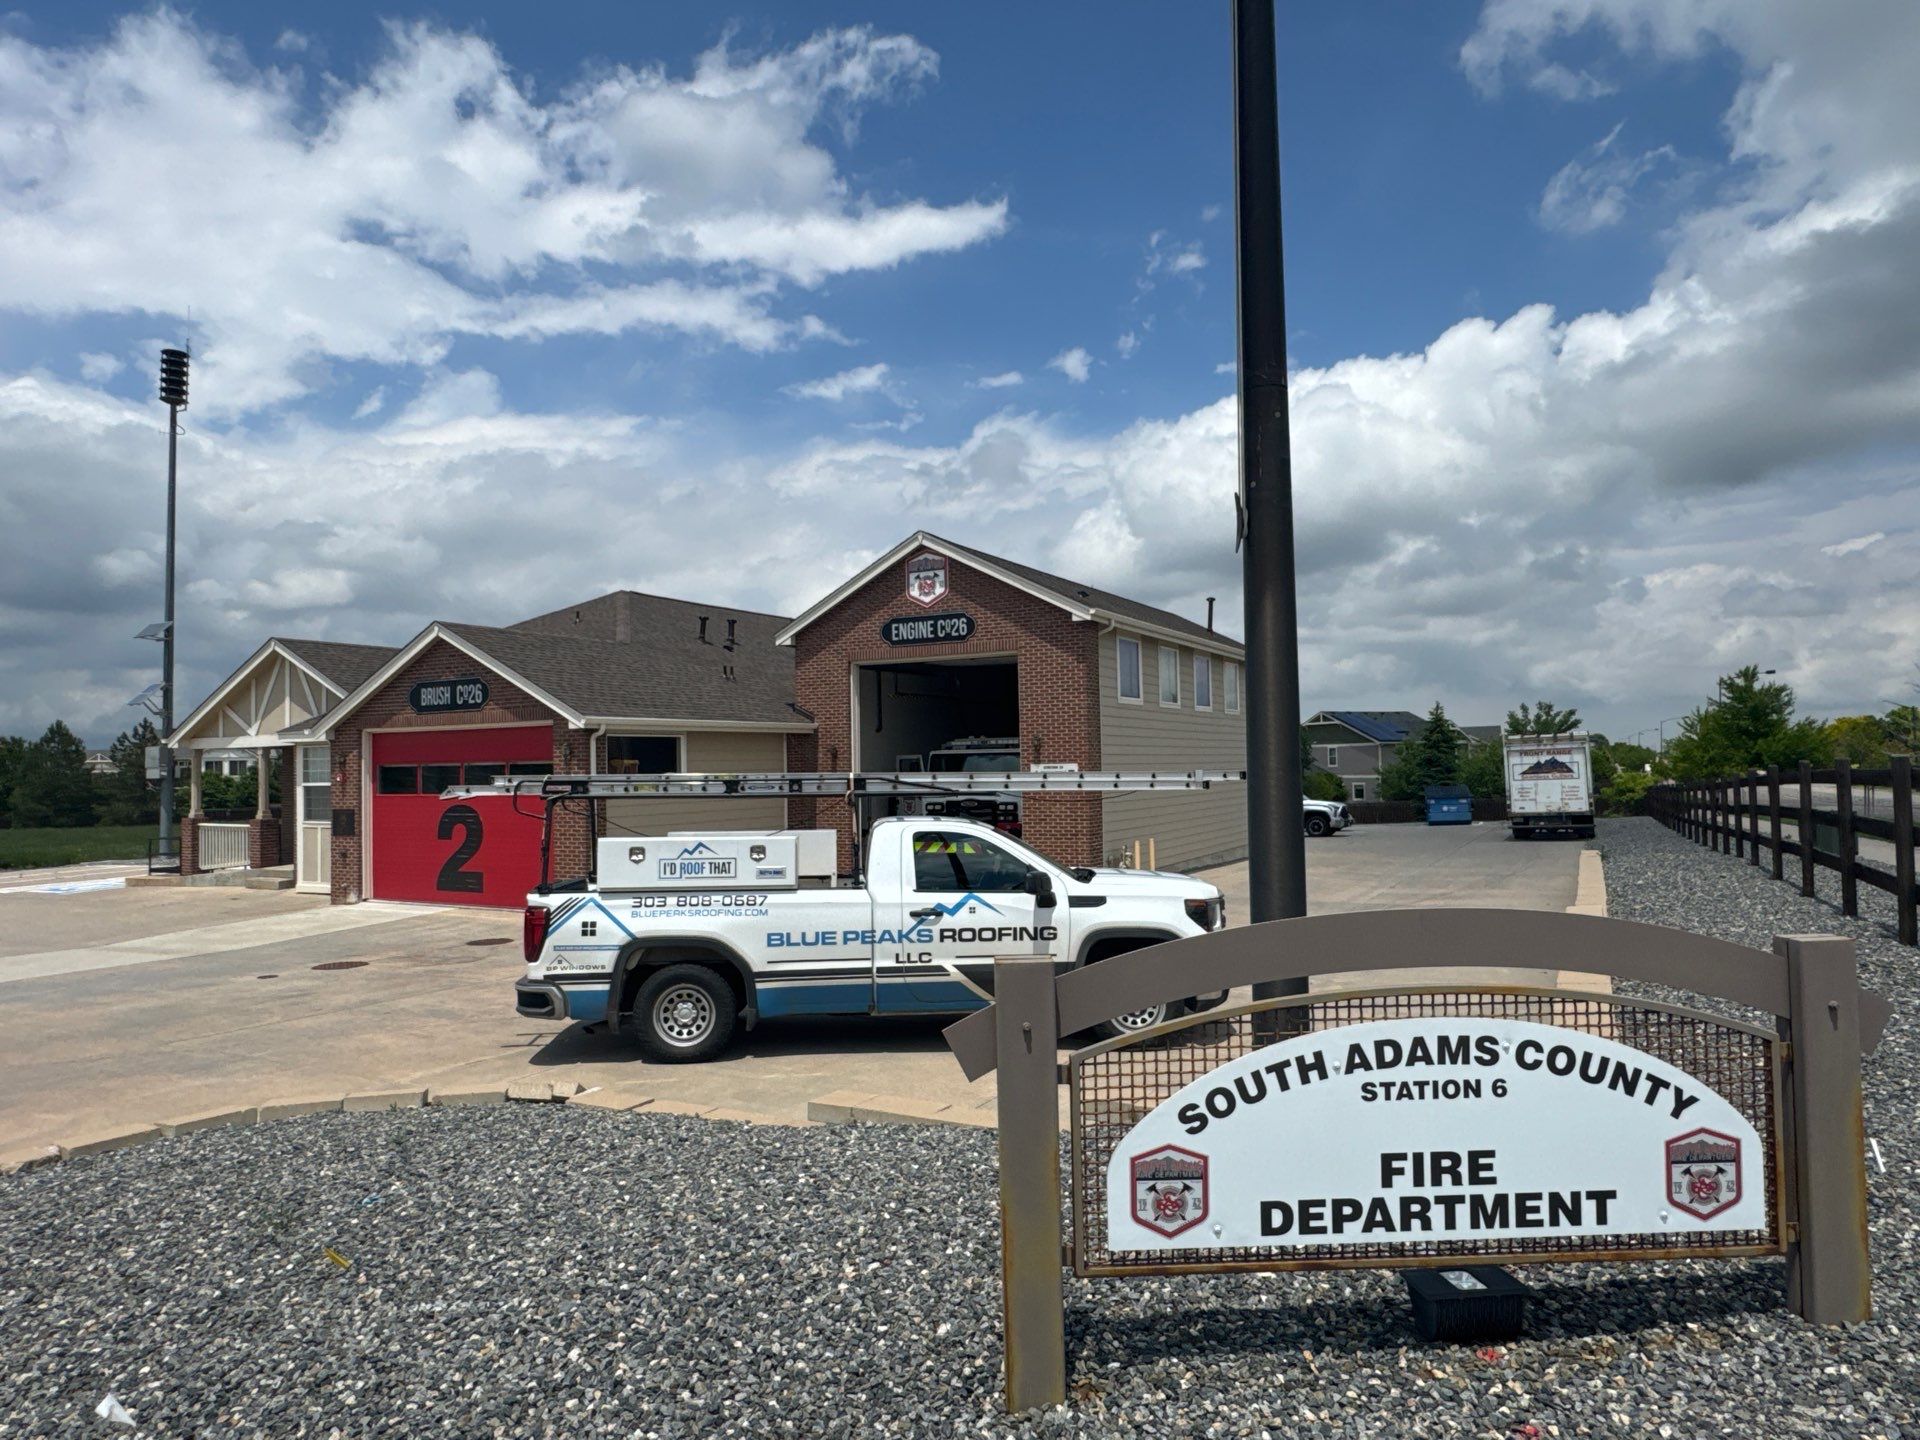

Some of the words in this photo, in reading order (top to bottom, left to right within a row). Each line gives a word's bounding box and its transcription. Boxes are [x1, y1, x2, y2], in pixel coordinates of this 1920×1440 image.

[892, 620, 935, 641] ENGINE
[421, 686, 451, 706] BRUSH
[437, 804, 484, 893] 2
[663, 862, 677, 876] I'D
[680, 861, 706, 876] ROOF
[708, 861, 732, 875] THAT
[632, 896, 667, 908] 303
[676, 895, 768, 908] 808-0687
[631, 908, 768, 919] BLUEPEAKSROOFING.COM
[767, 930, 837, 947] BLUE
[843, 927, 934, 945] PEAKS
[939, 926, 1058, 943] ROOFING
[895, 952, 932, 964] LLC
[1178, 1050, 1329, 1135] SOUTH
[1344, 1035, 1500, 1075] ADAMS
[1515, 1039, 1700, 1120] COUNTY
[1361, 1079, 1482, 1102] STATION
[1491, 1078, 1508, 1098] 6
[1380, 1150, 1497, 1188] FIRE
[1260, 1190, 1617, 1237] DEPARTMENT
